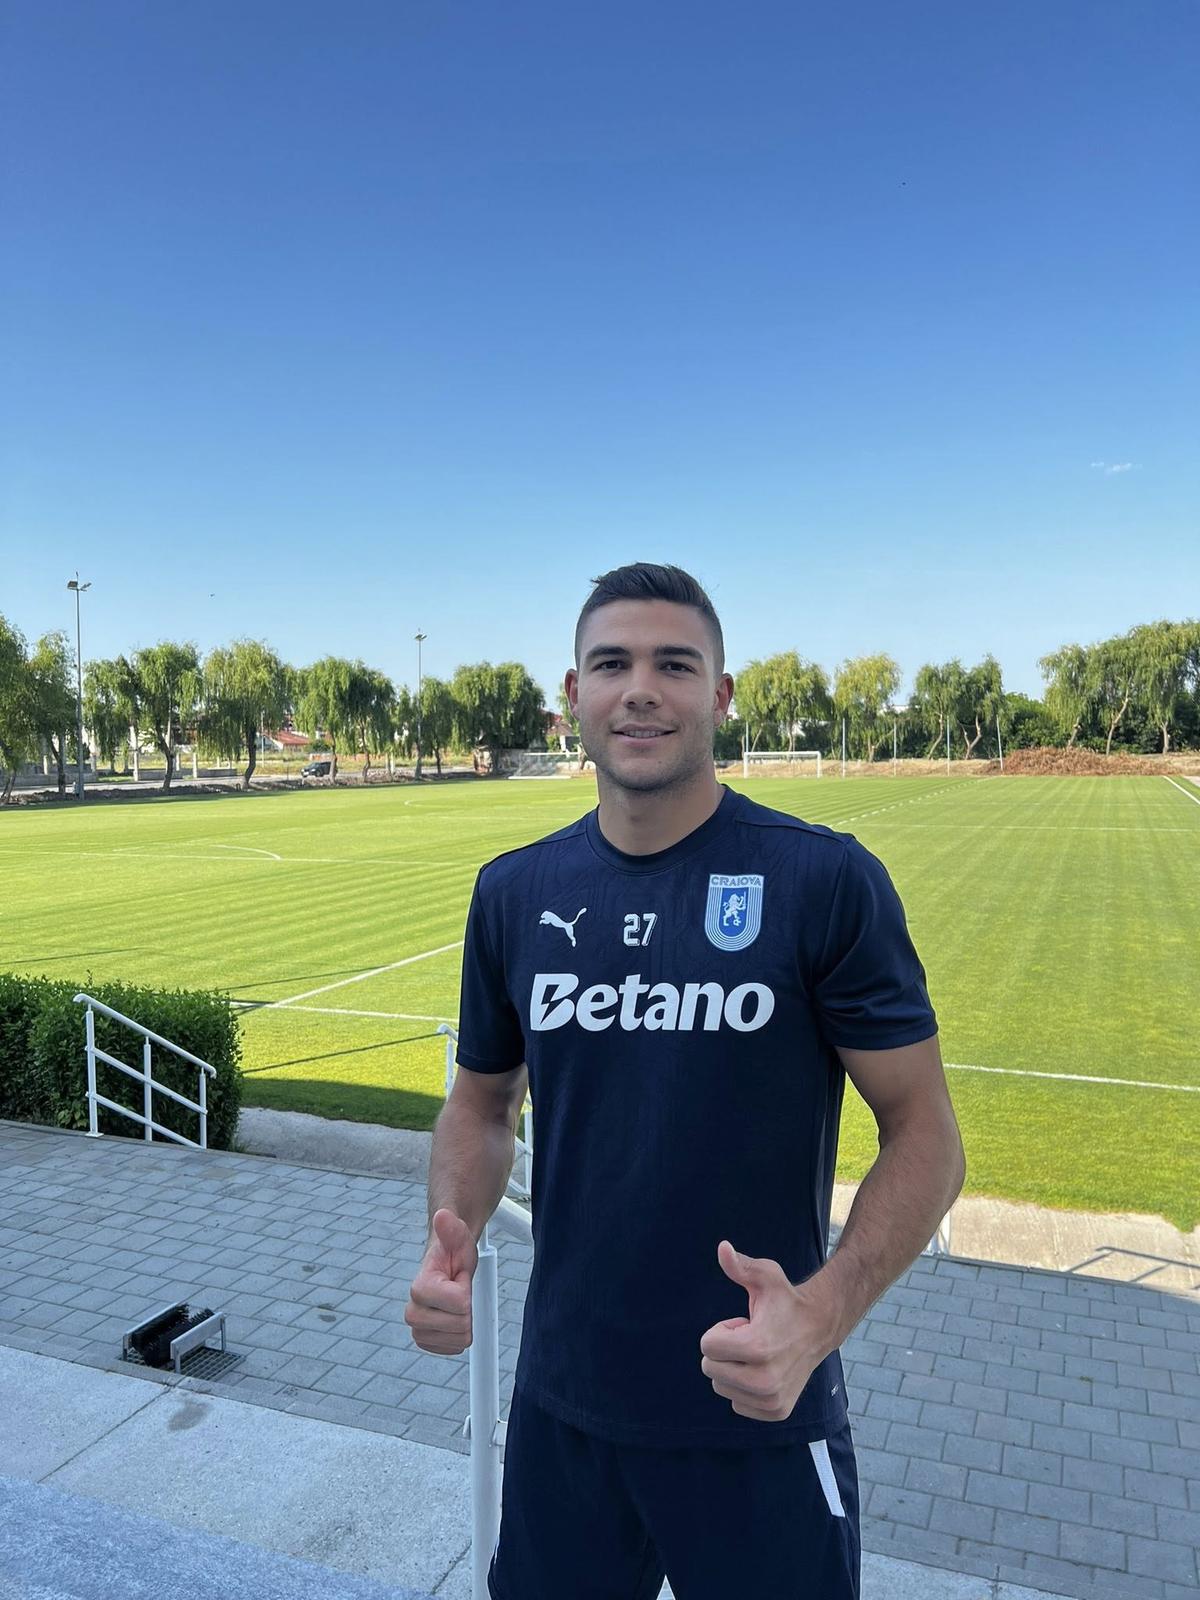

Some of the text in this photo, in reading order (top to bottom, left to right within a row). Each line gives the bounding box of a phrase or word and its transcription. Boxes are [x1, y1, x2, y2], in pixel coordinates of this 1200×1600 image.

[711, 876, 761, 887] CRAIOVA
[623, 913, 658, 947] 27
[529, 973, 775, 1032] Betano
